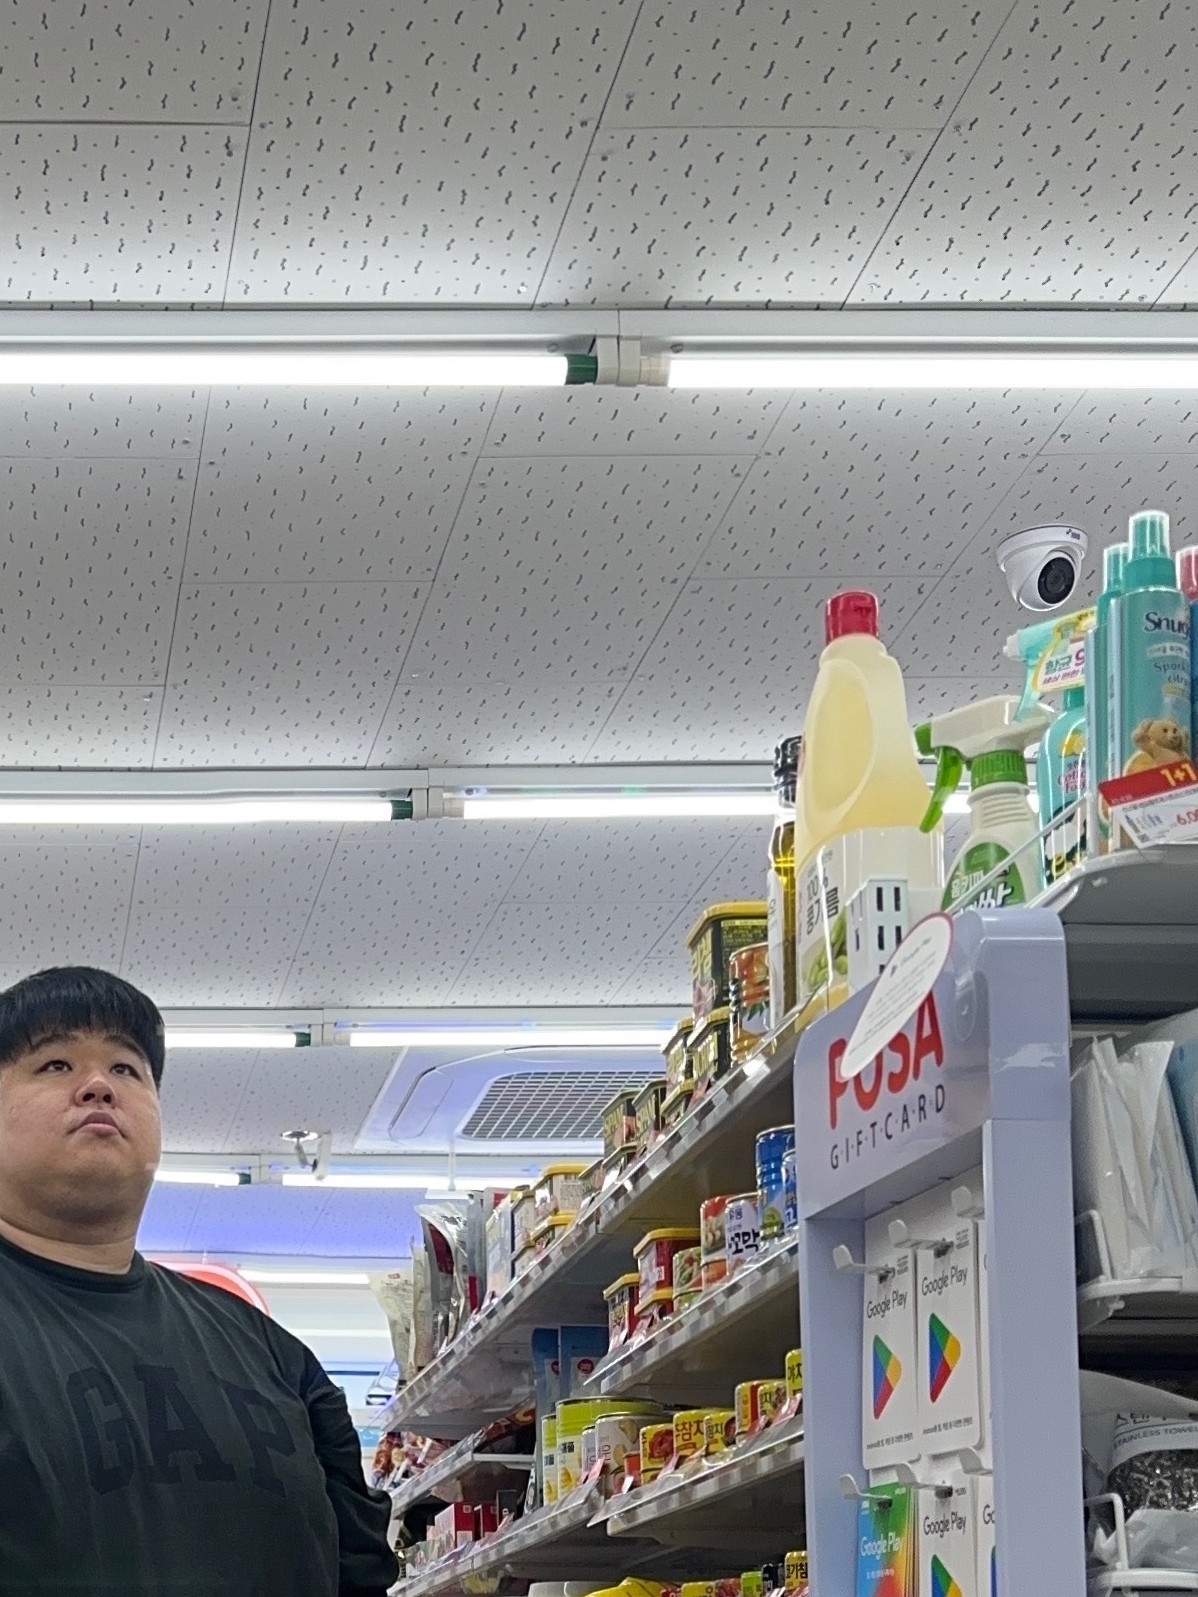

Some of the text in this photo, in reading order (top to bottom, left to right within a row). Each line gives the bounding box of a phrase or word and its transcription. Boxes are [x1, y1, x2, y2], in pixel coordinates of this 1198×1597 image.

[1160, 763, 1198, 788] 1+1
[921, 1265, 968, 1297] Google Play
[867, 1290, 908, 1319] Google Play
[65, 1365, 299, 1496] GAP
[923, 1512, 967, 1538] Google Play
[860, 1535, 888, 1560] Google
